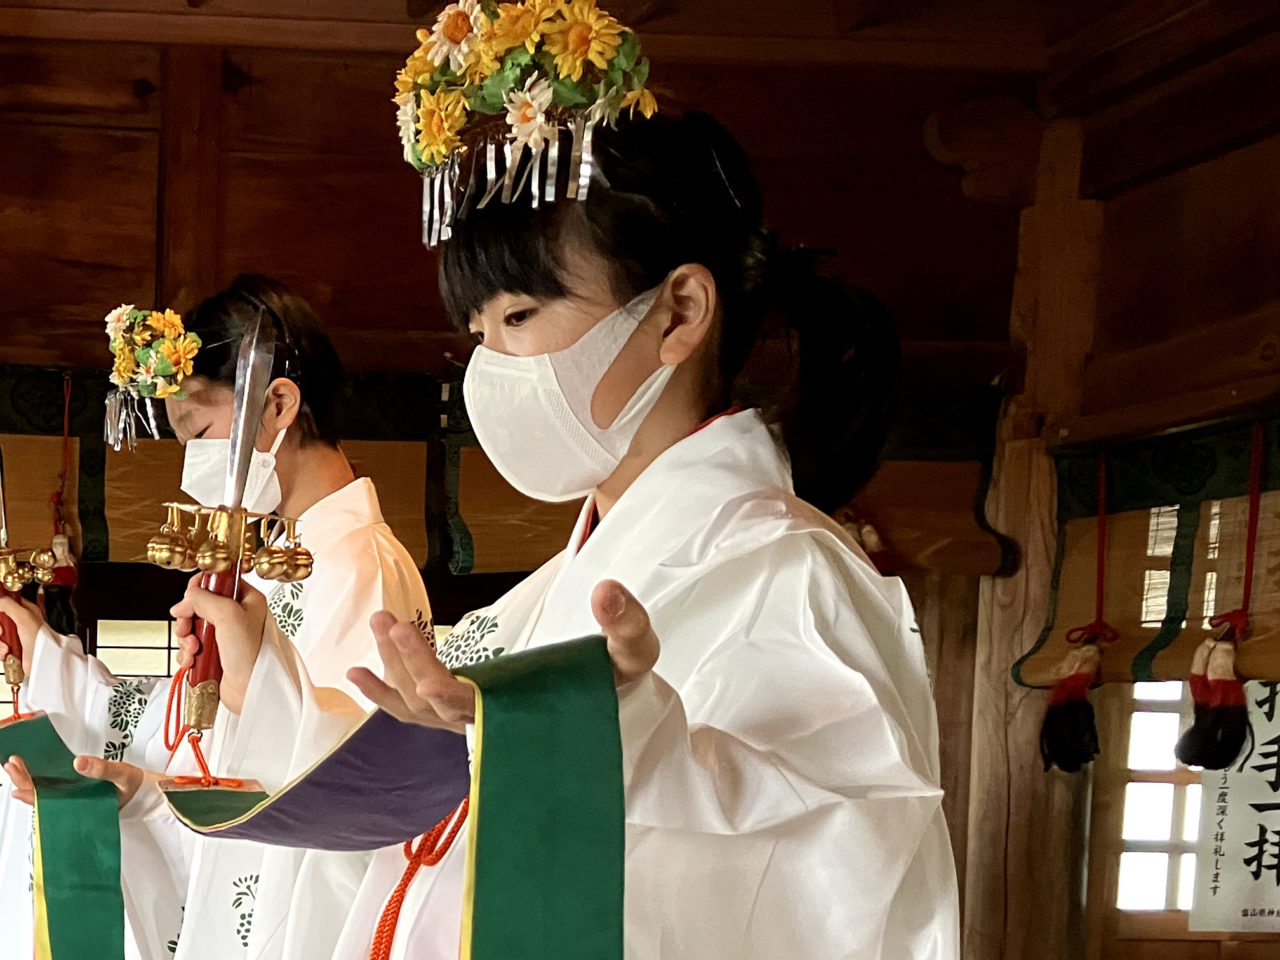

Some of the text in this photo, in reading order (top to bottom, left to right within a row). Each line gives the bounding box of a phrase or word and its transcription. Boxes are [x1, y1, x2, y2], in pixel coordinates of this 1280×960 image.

[1208, 767, 1230, 897] う一度深く拝礼します
[1243, 681, 1280, 888] 手一拝
